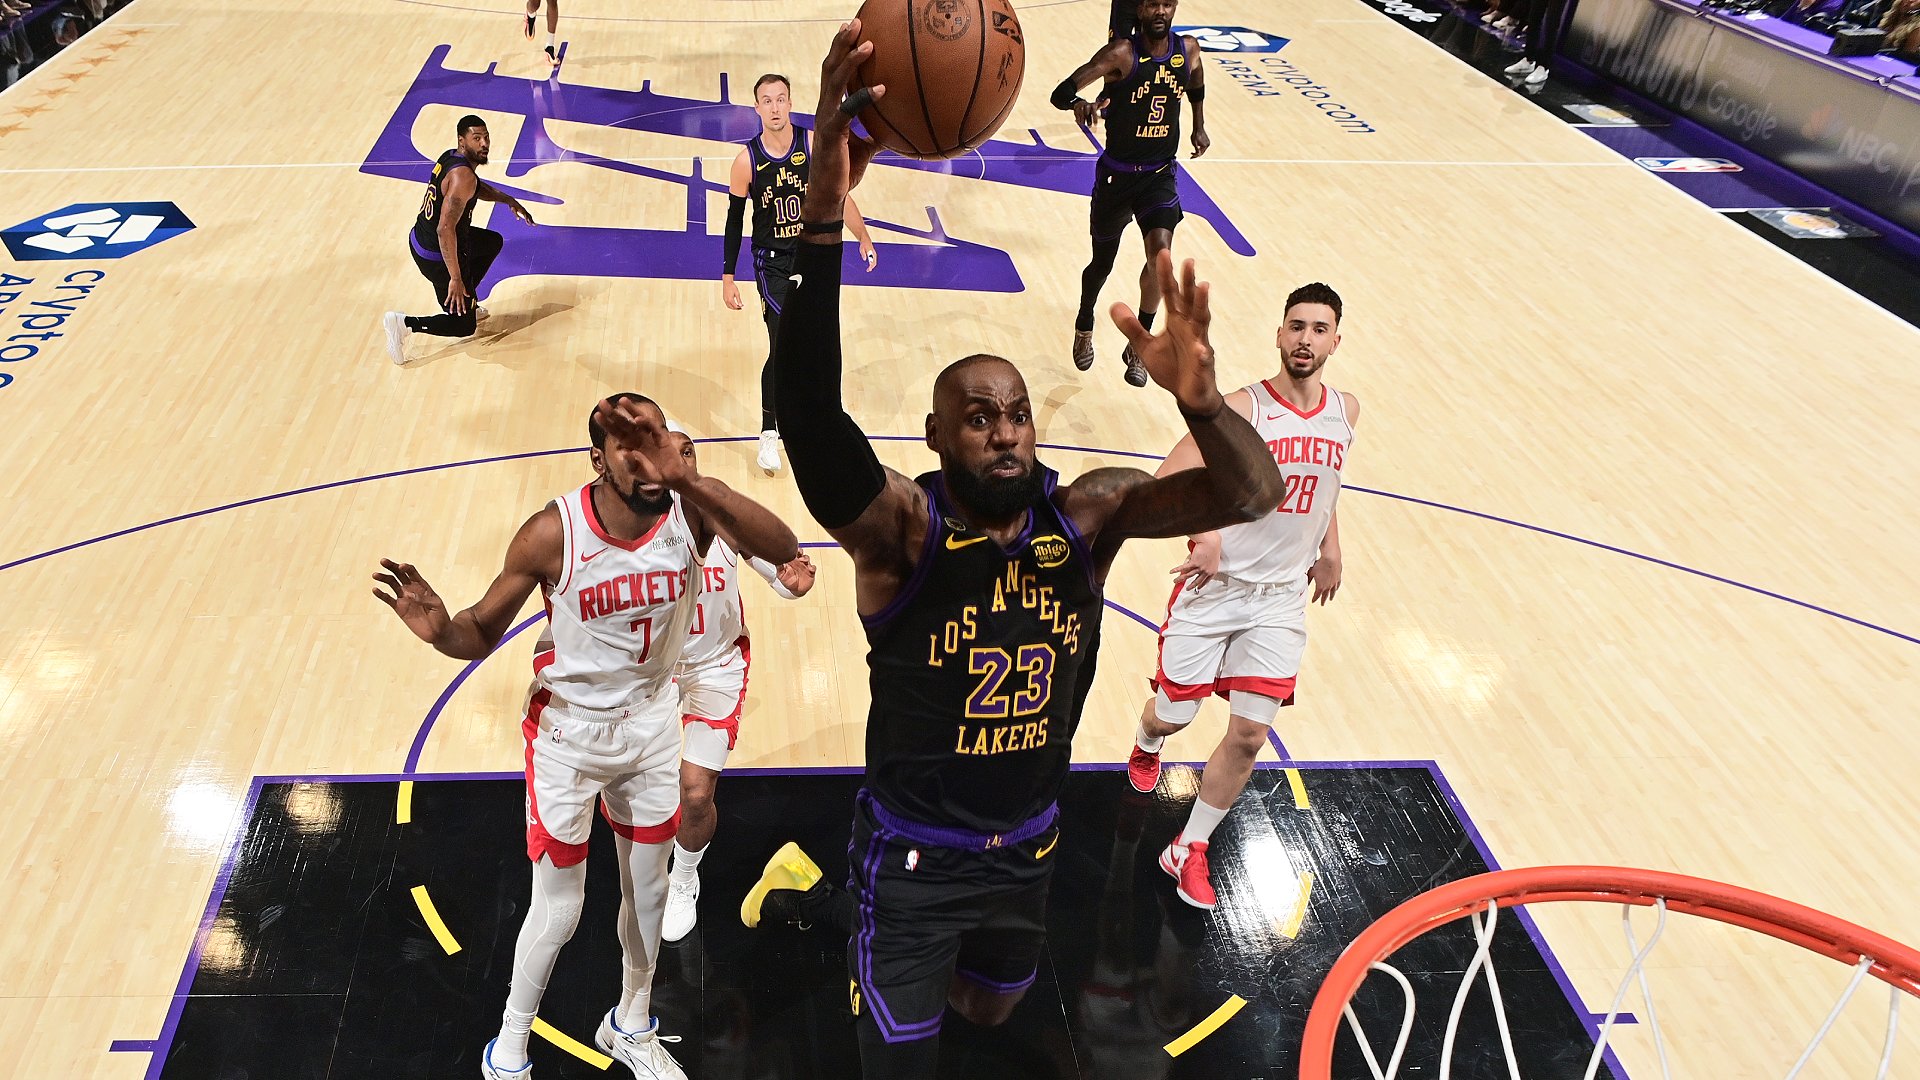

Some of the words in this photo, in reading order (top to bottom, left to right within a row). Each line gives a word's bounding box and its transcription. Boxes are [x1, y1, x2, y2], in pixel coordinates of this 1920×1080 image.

[1130, 81, 1150, 104] LOS
[1154, 65, 1184, 101] ANGELE
[1212, 57, 1281, 97] ARENA
[1259, 57, 1376, 133] crypto.com
[1147, 95, 1168, 123] 5
[1706, 79, 1778, 141] Google
[1136, 125, 1170, 138] LAKERS
[1837, 126, 1898, 173] NBC
[761, 185, 774, 209] LOS
[776, 166, 809, 196] ANGELE
[773, 194, 802, 225] 10
[1276, 474, 1319, 514] 28
[578, 567, 688, 622] ROCKETS
[928, 604, 978, 667] LOS
[991, 560, 1081, 655] ANGELES
[629, 617, 653, 665] 7
[964, 642, 1056, 719] 23
[955, 717, 1049, 755] LAKERS
